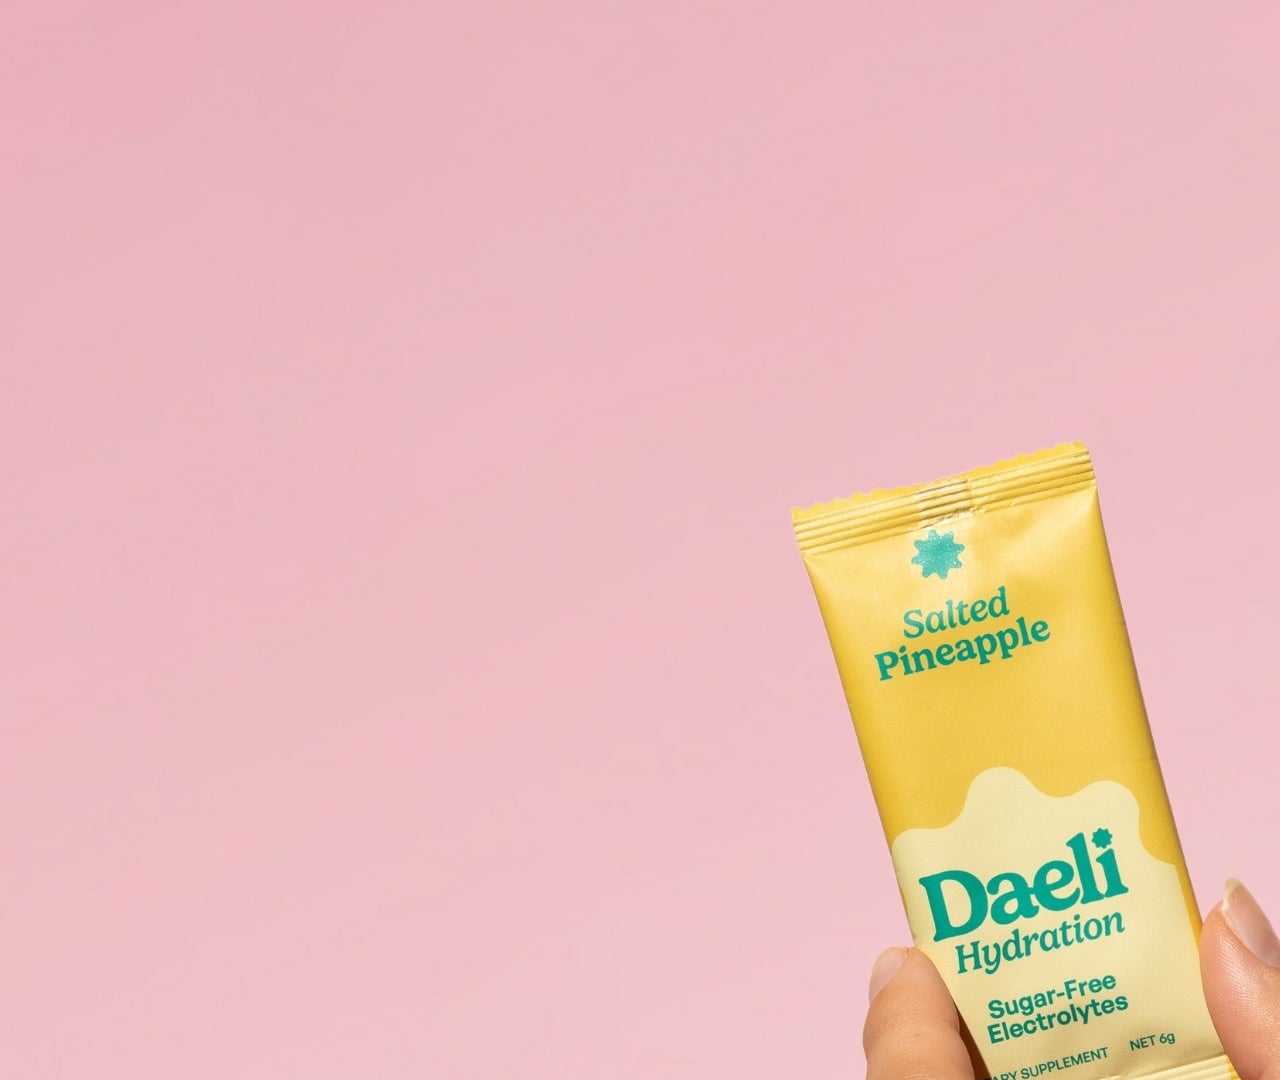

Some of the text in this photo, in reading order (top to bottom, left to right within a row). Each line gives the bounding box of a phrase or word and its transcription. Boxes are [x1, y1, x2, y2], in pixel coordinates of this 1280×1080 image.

[903, 585, 1010, 639] Salted
[874, 616, 1051, 681] Pineapple
[918, 827, 1129, 942] Daeli
[955, 912, 1125, 975] Hydration
[987, 995, 1129, 1044] Electrolytes
[988, 975, 1116, 1019] Sugar-Free
[1020, 1047, 1109, 1080] SUPPLEMENT
[1129, 1032, 1176, 1051] NET 6g
